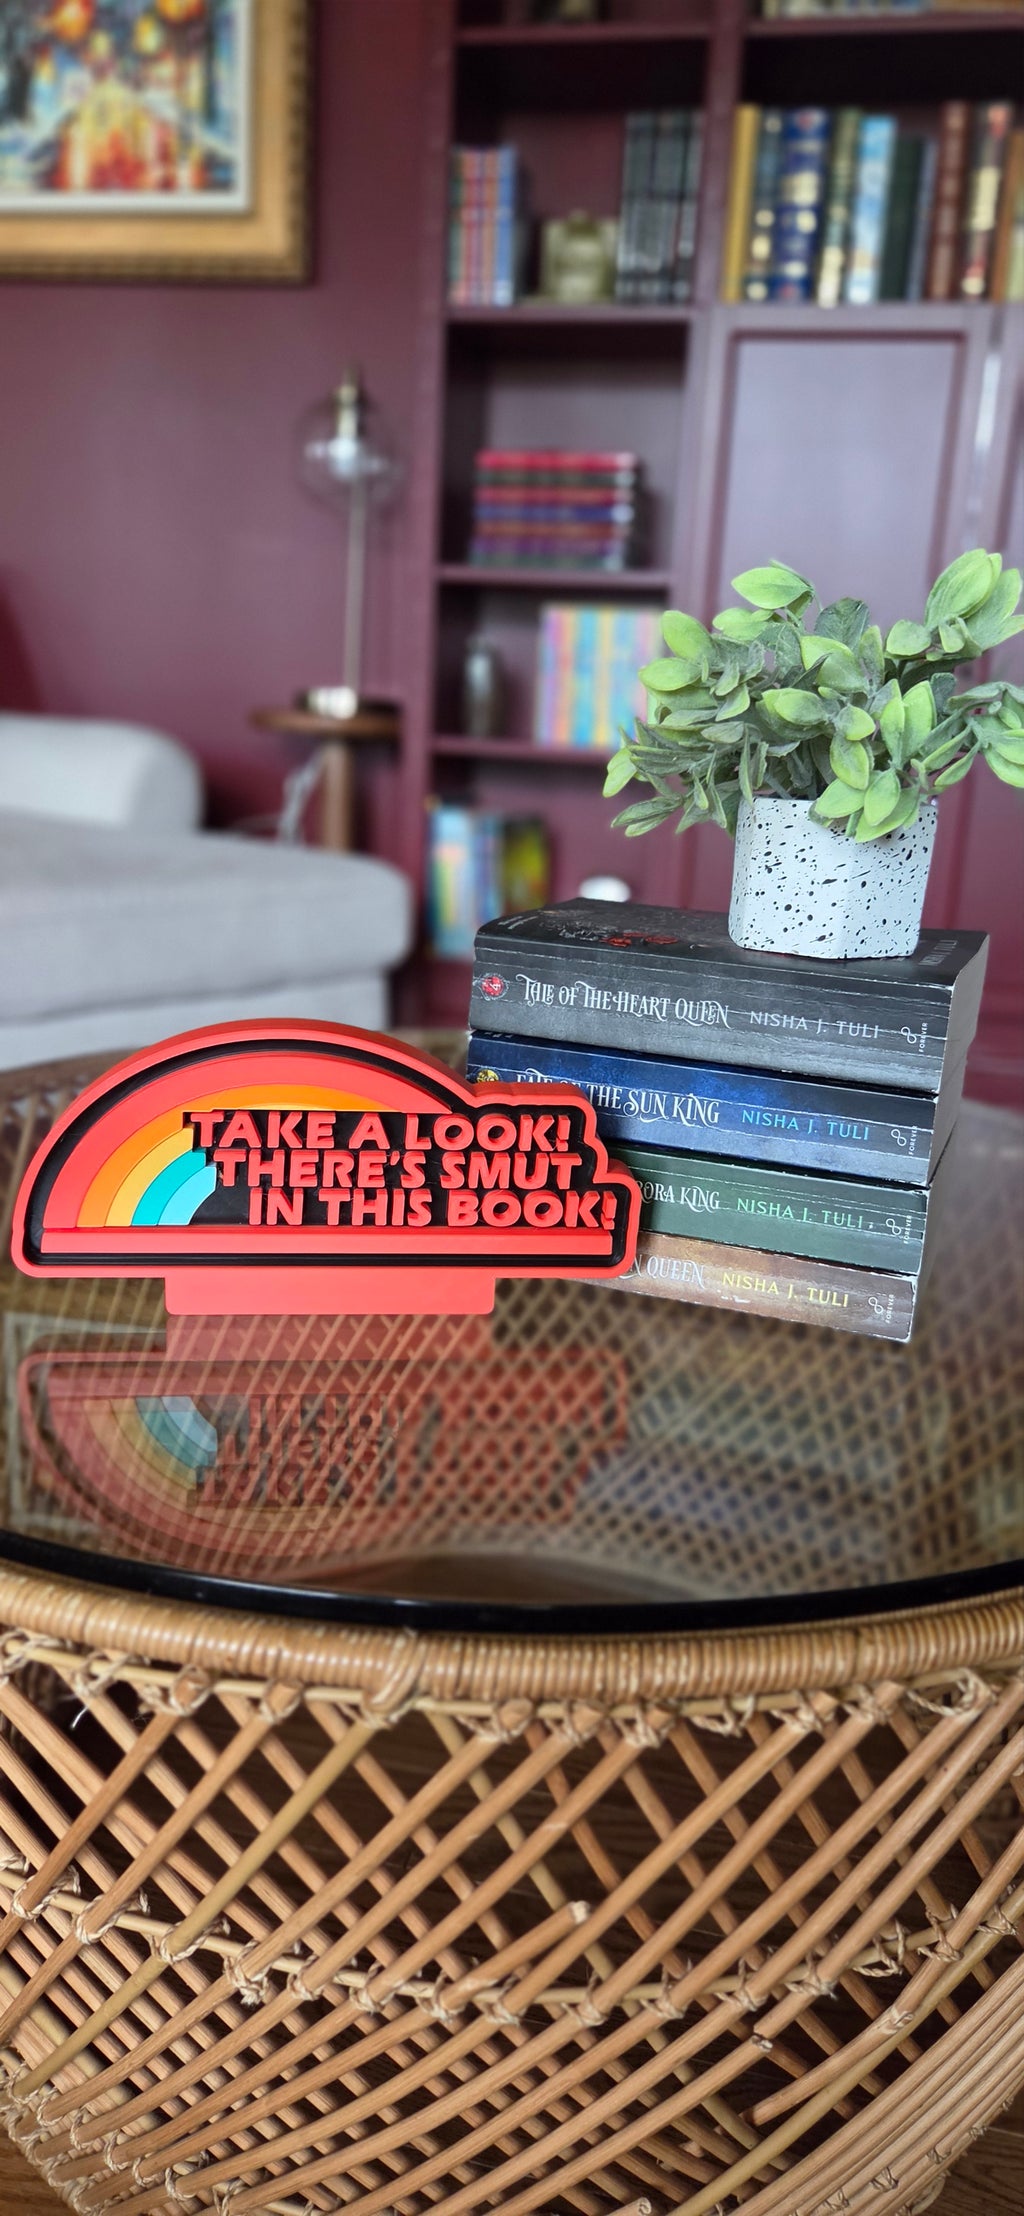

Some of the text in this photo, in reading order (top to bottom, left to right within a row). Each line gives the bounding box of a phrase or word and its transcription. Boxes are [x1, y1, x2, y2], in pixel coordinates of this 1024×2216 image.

[516, 973, 733, 1029] TALE OF THE HEART QUEEN
[750, 1010, 880, 1039] NISHA J. TULI
[586, 1084, 720, 1127] THE SUN KING
[190, 1111, 571, 1152] TAKE A LOOK!
[742, 1109, 870, 1140] NISHA J. TULI
[213, 1149, 583, 1190] THERE'S SMUT
[249, 1187, 618, 1230] IN THIS BOOK!
[680, 1185, 720, 1213] KING
[737, 1197, 864, 1229] NISHA J. TULI
[646, 1255, 705, 1289] QUEEN
[722, 1271, 849, 1308] NISHA J. TULI
